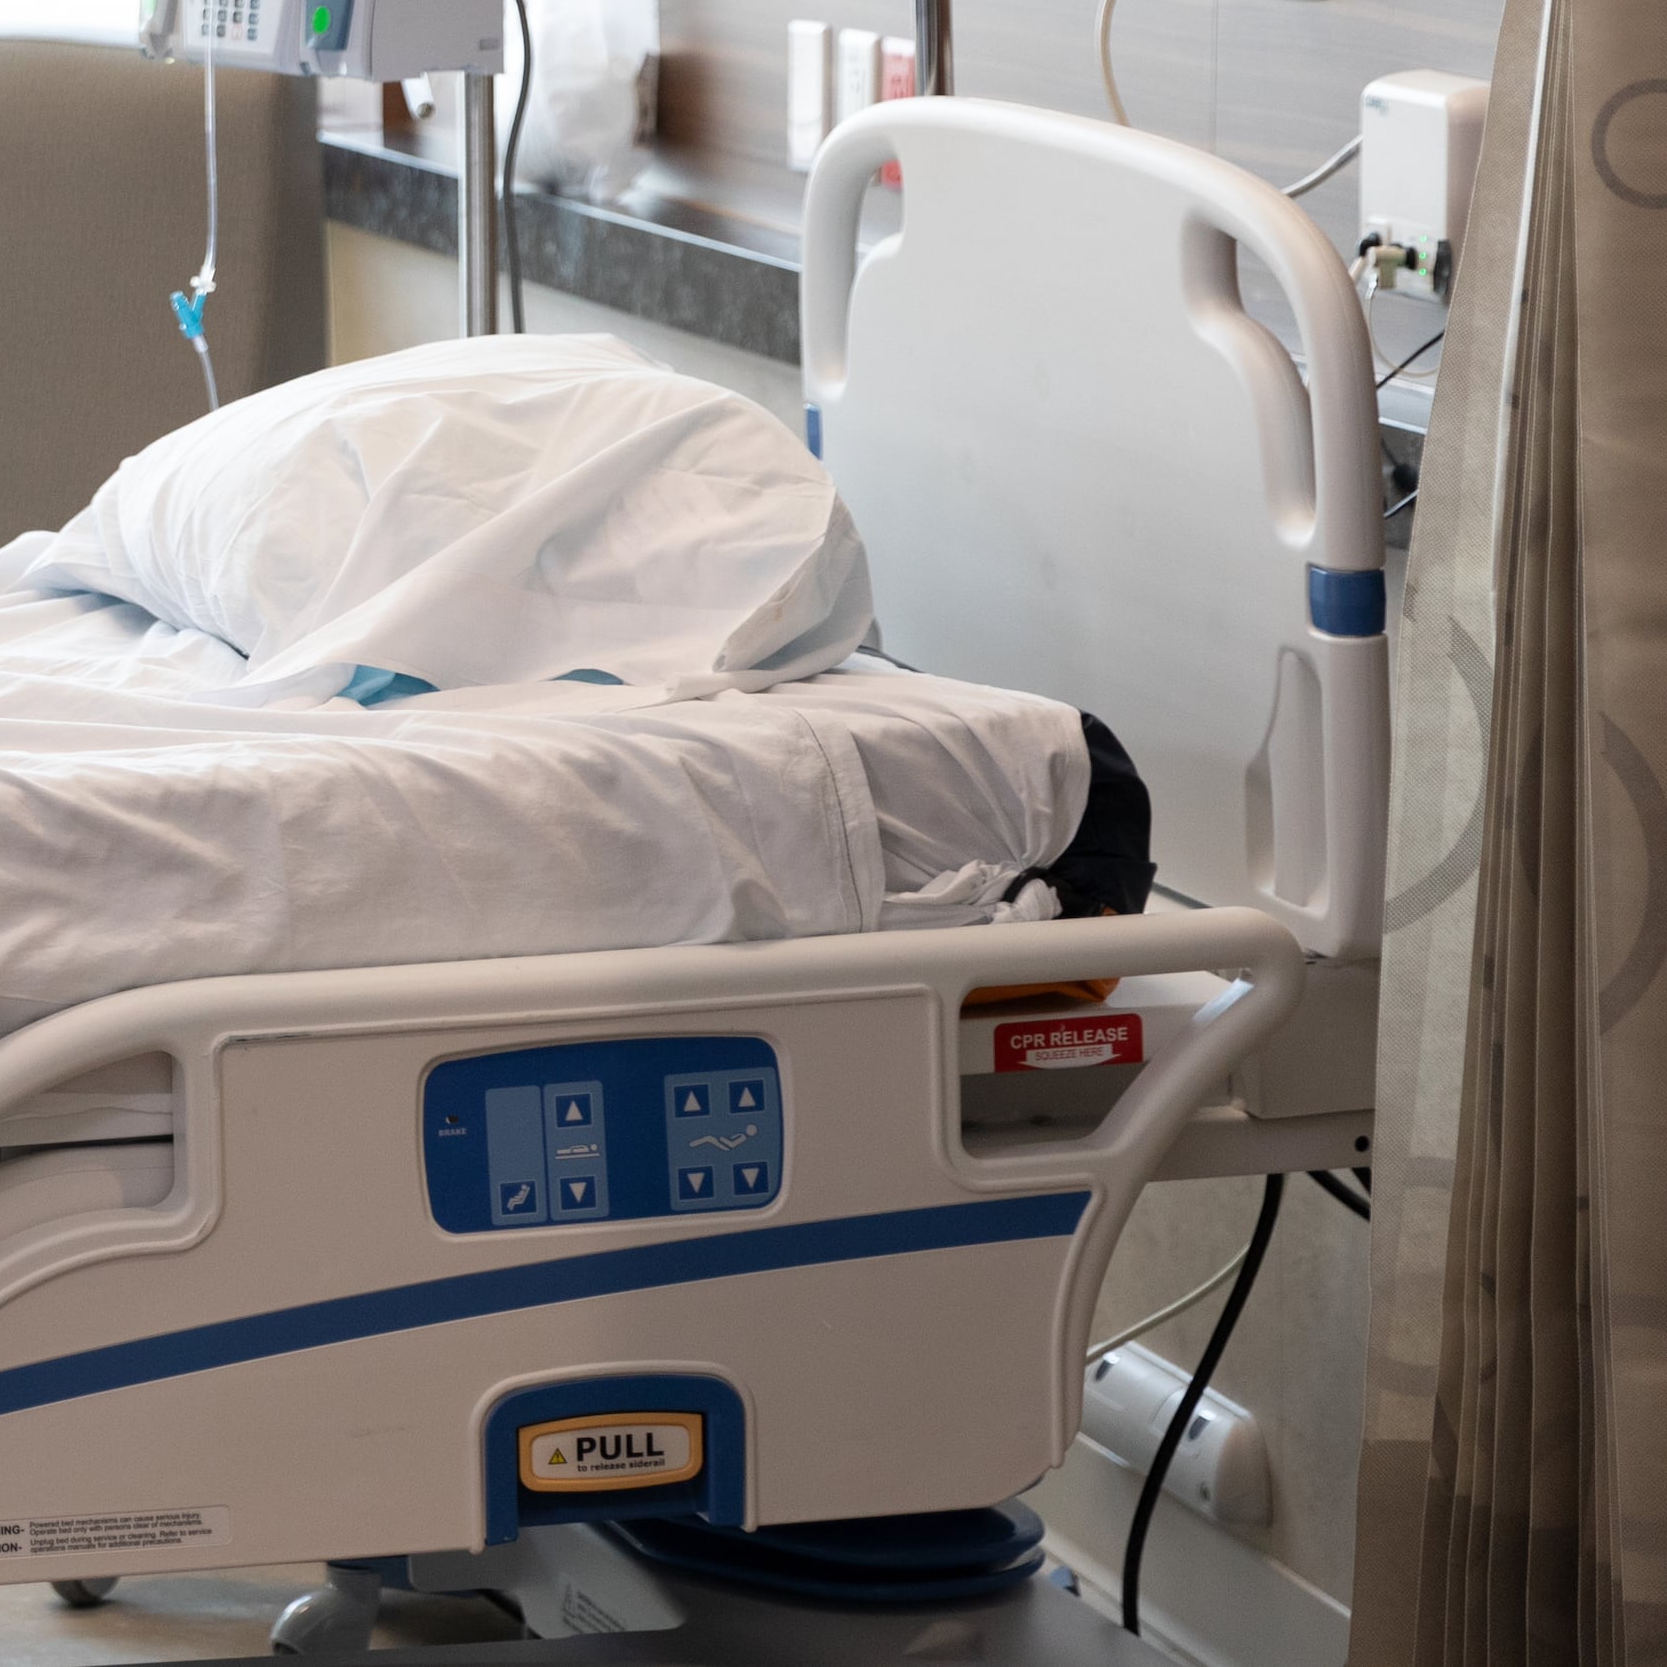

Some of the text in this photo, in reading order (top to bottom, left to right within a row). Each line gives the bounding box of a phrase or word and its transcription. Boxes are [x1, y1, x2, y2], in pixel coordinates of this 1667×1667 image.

[1010, 1026, 1128, 1050] CPR RELEASE
[1035, 1046, 1103, 1061] SQUEEZE HERE
[438, 1128, 467, 1137] BRAKE
[576, 1432, 664, 1462] PULL
[577, 1459, 665, 1472] to release siderail
[29, 1520, 60, 1529] Powered
[61, 1519, 74, 1527] bed
[75, 1517, 118, 1527] mechanisms
[29, 1528, 58, 1536] Operate
[73, 1526, 87, 1534] only
[104, 1523, 132, 1531] persons
[30, 1538, 54, 1547] Unplug
[70, 1536, 92, 1544] during
[188, 1528, 213, 1536] service
[30, 1545, 66, 1553] operations
[67, 1543, 96, 1551] manuals
[108, 1540, 140, 1548] additional
